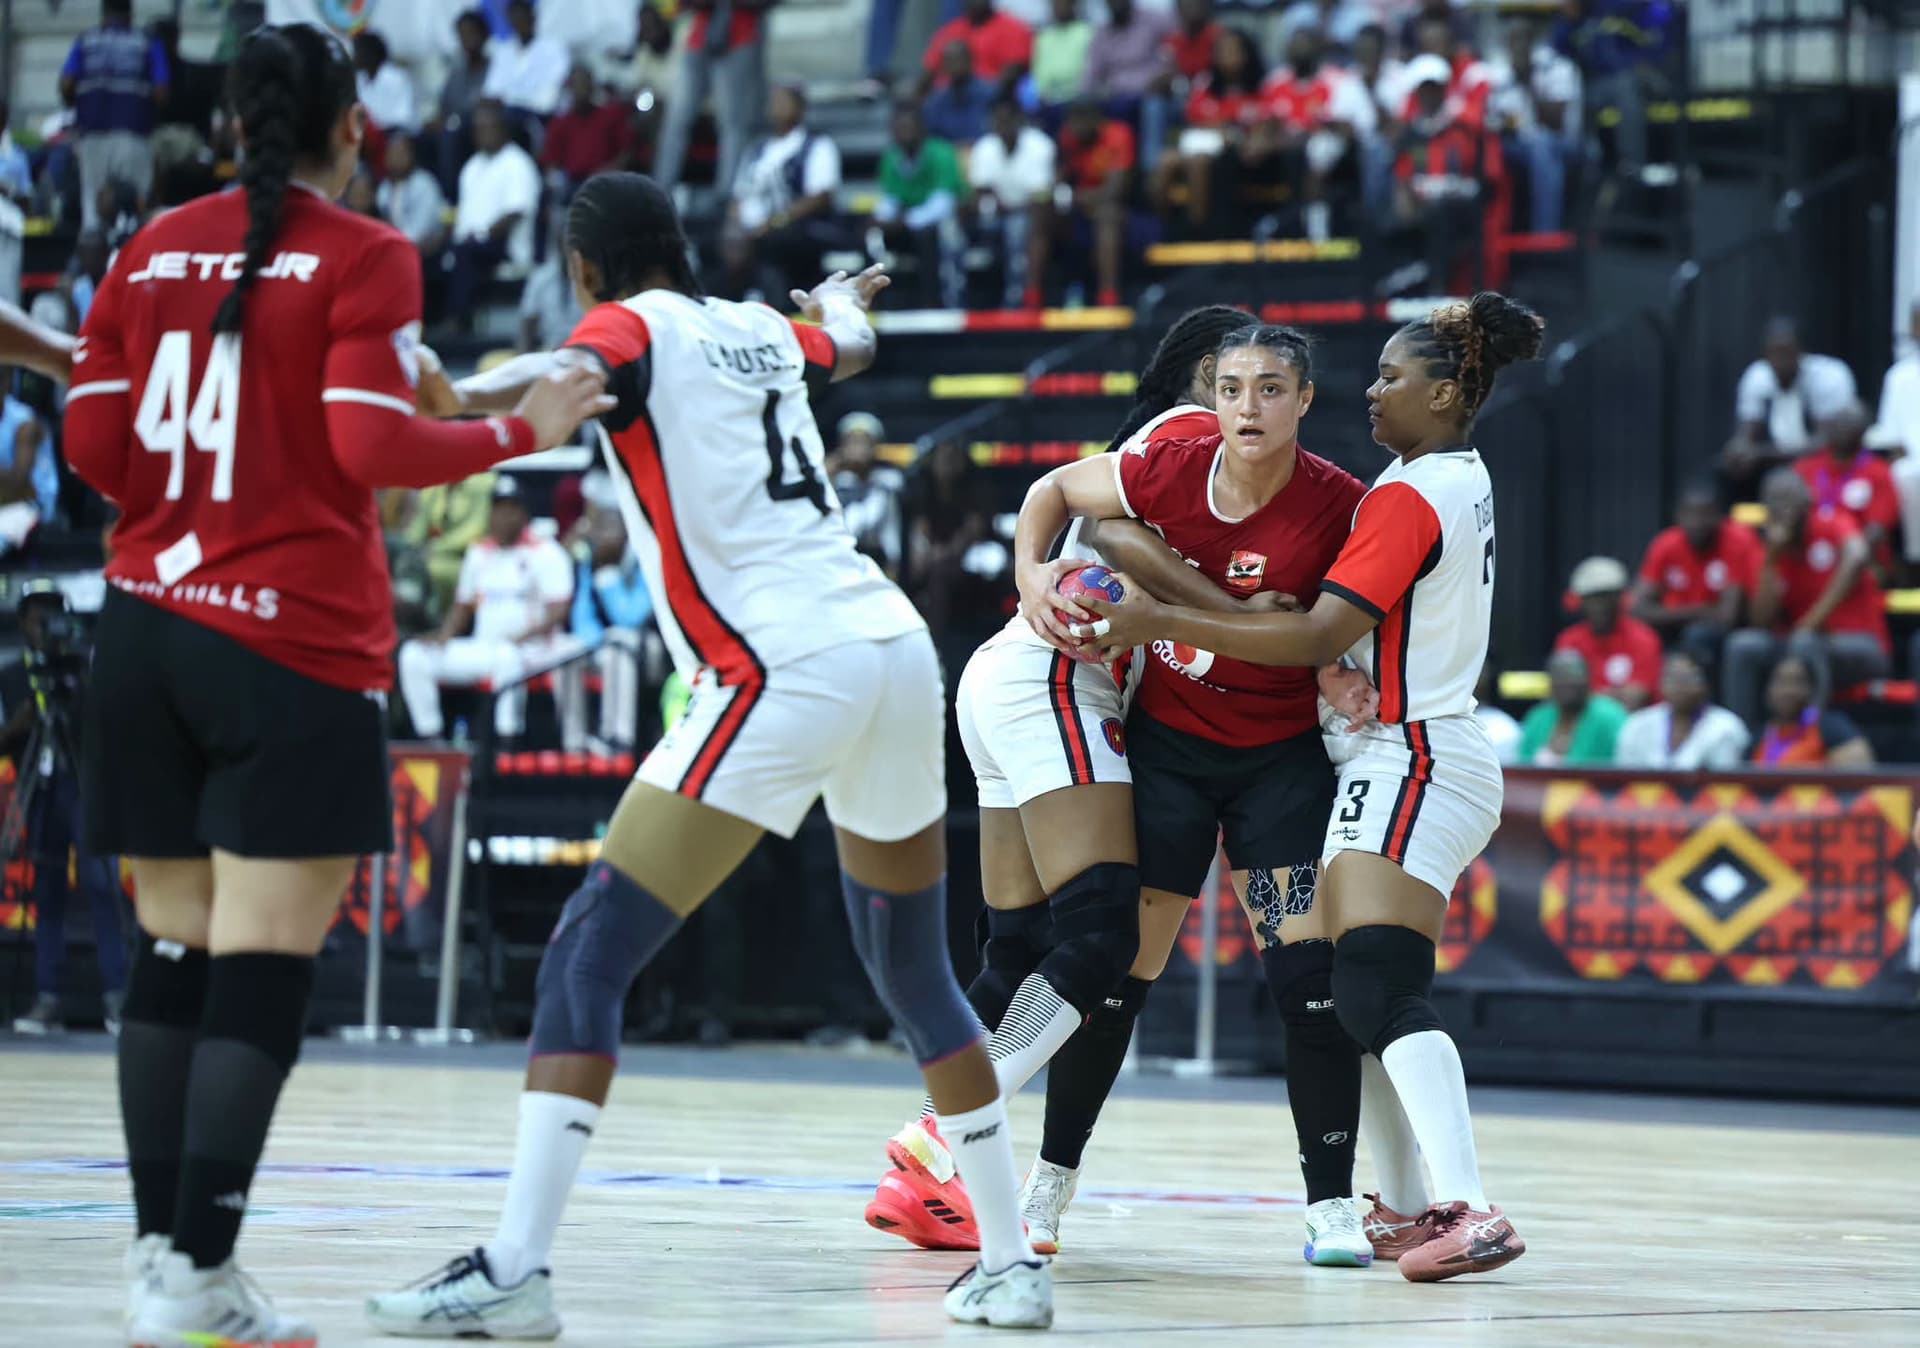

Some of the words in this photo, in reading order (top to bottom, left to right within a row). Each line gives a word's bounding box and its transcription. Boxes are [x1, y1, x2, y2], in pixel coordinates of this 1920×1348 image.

[134, 331, 242, 502] 44
[762, 388, 832, 517] 4
[1339, 780, 1371, 822] 3
[1306, 999, 1335, 1010] SELEC
